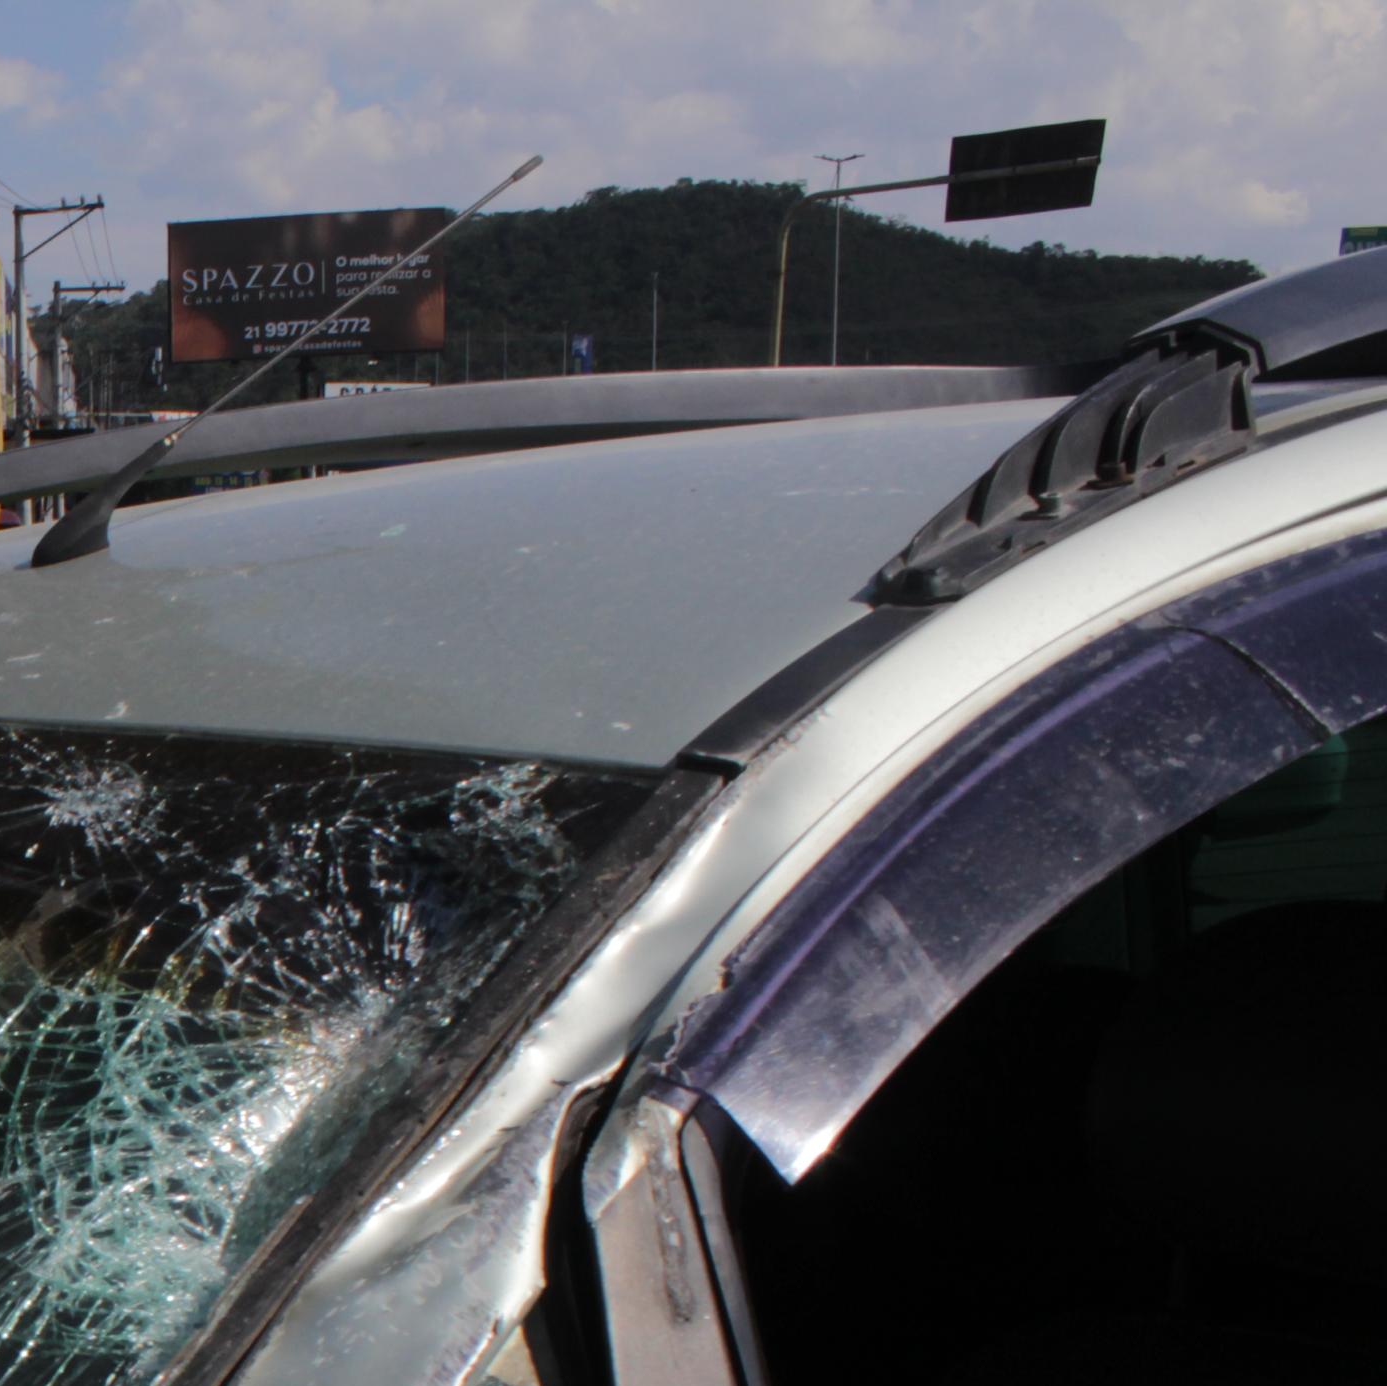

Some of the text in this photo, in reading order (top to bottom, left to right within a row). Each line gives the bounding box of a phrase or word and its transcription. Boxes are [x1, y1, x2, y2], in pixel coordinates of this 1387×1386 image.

[335, 253, 430, 267] O melhor lgar
[182, 262, 315, 292] SPAZZO
[336, 271, 367, 285] para
[422, 269, 431, 279] a
[183, 289, 315, 305] Casa de Festas
[244, 326, 260, 339] 21
